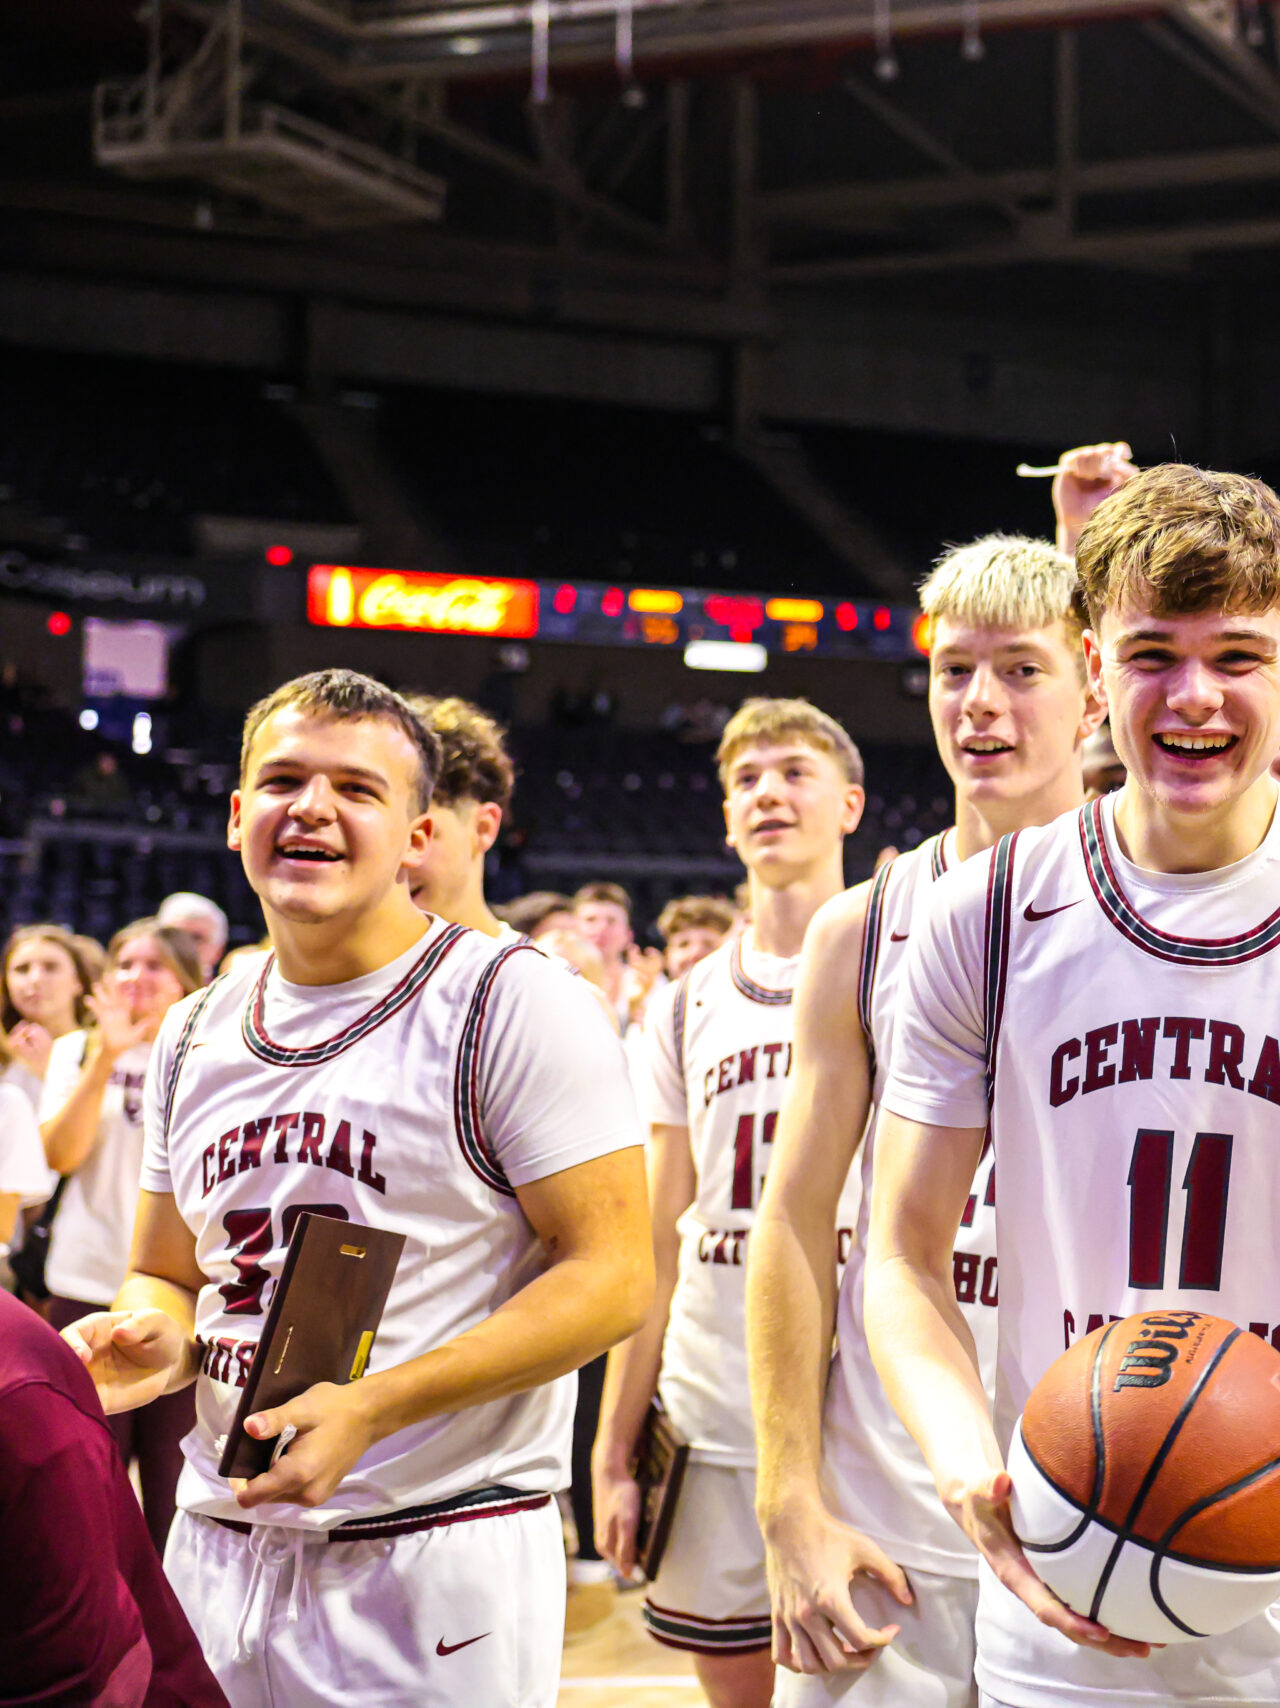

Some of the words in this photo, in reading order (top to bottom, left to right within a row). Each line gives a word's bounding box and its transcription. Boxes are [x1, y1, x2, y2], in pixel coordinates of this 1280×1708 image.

[703, 1041, 793, 1108] CENT
[201, 1111, 387, 1199] CENTRAL
[1127, 1128, 1234, 1292] 11
